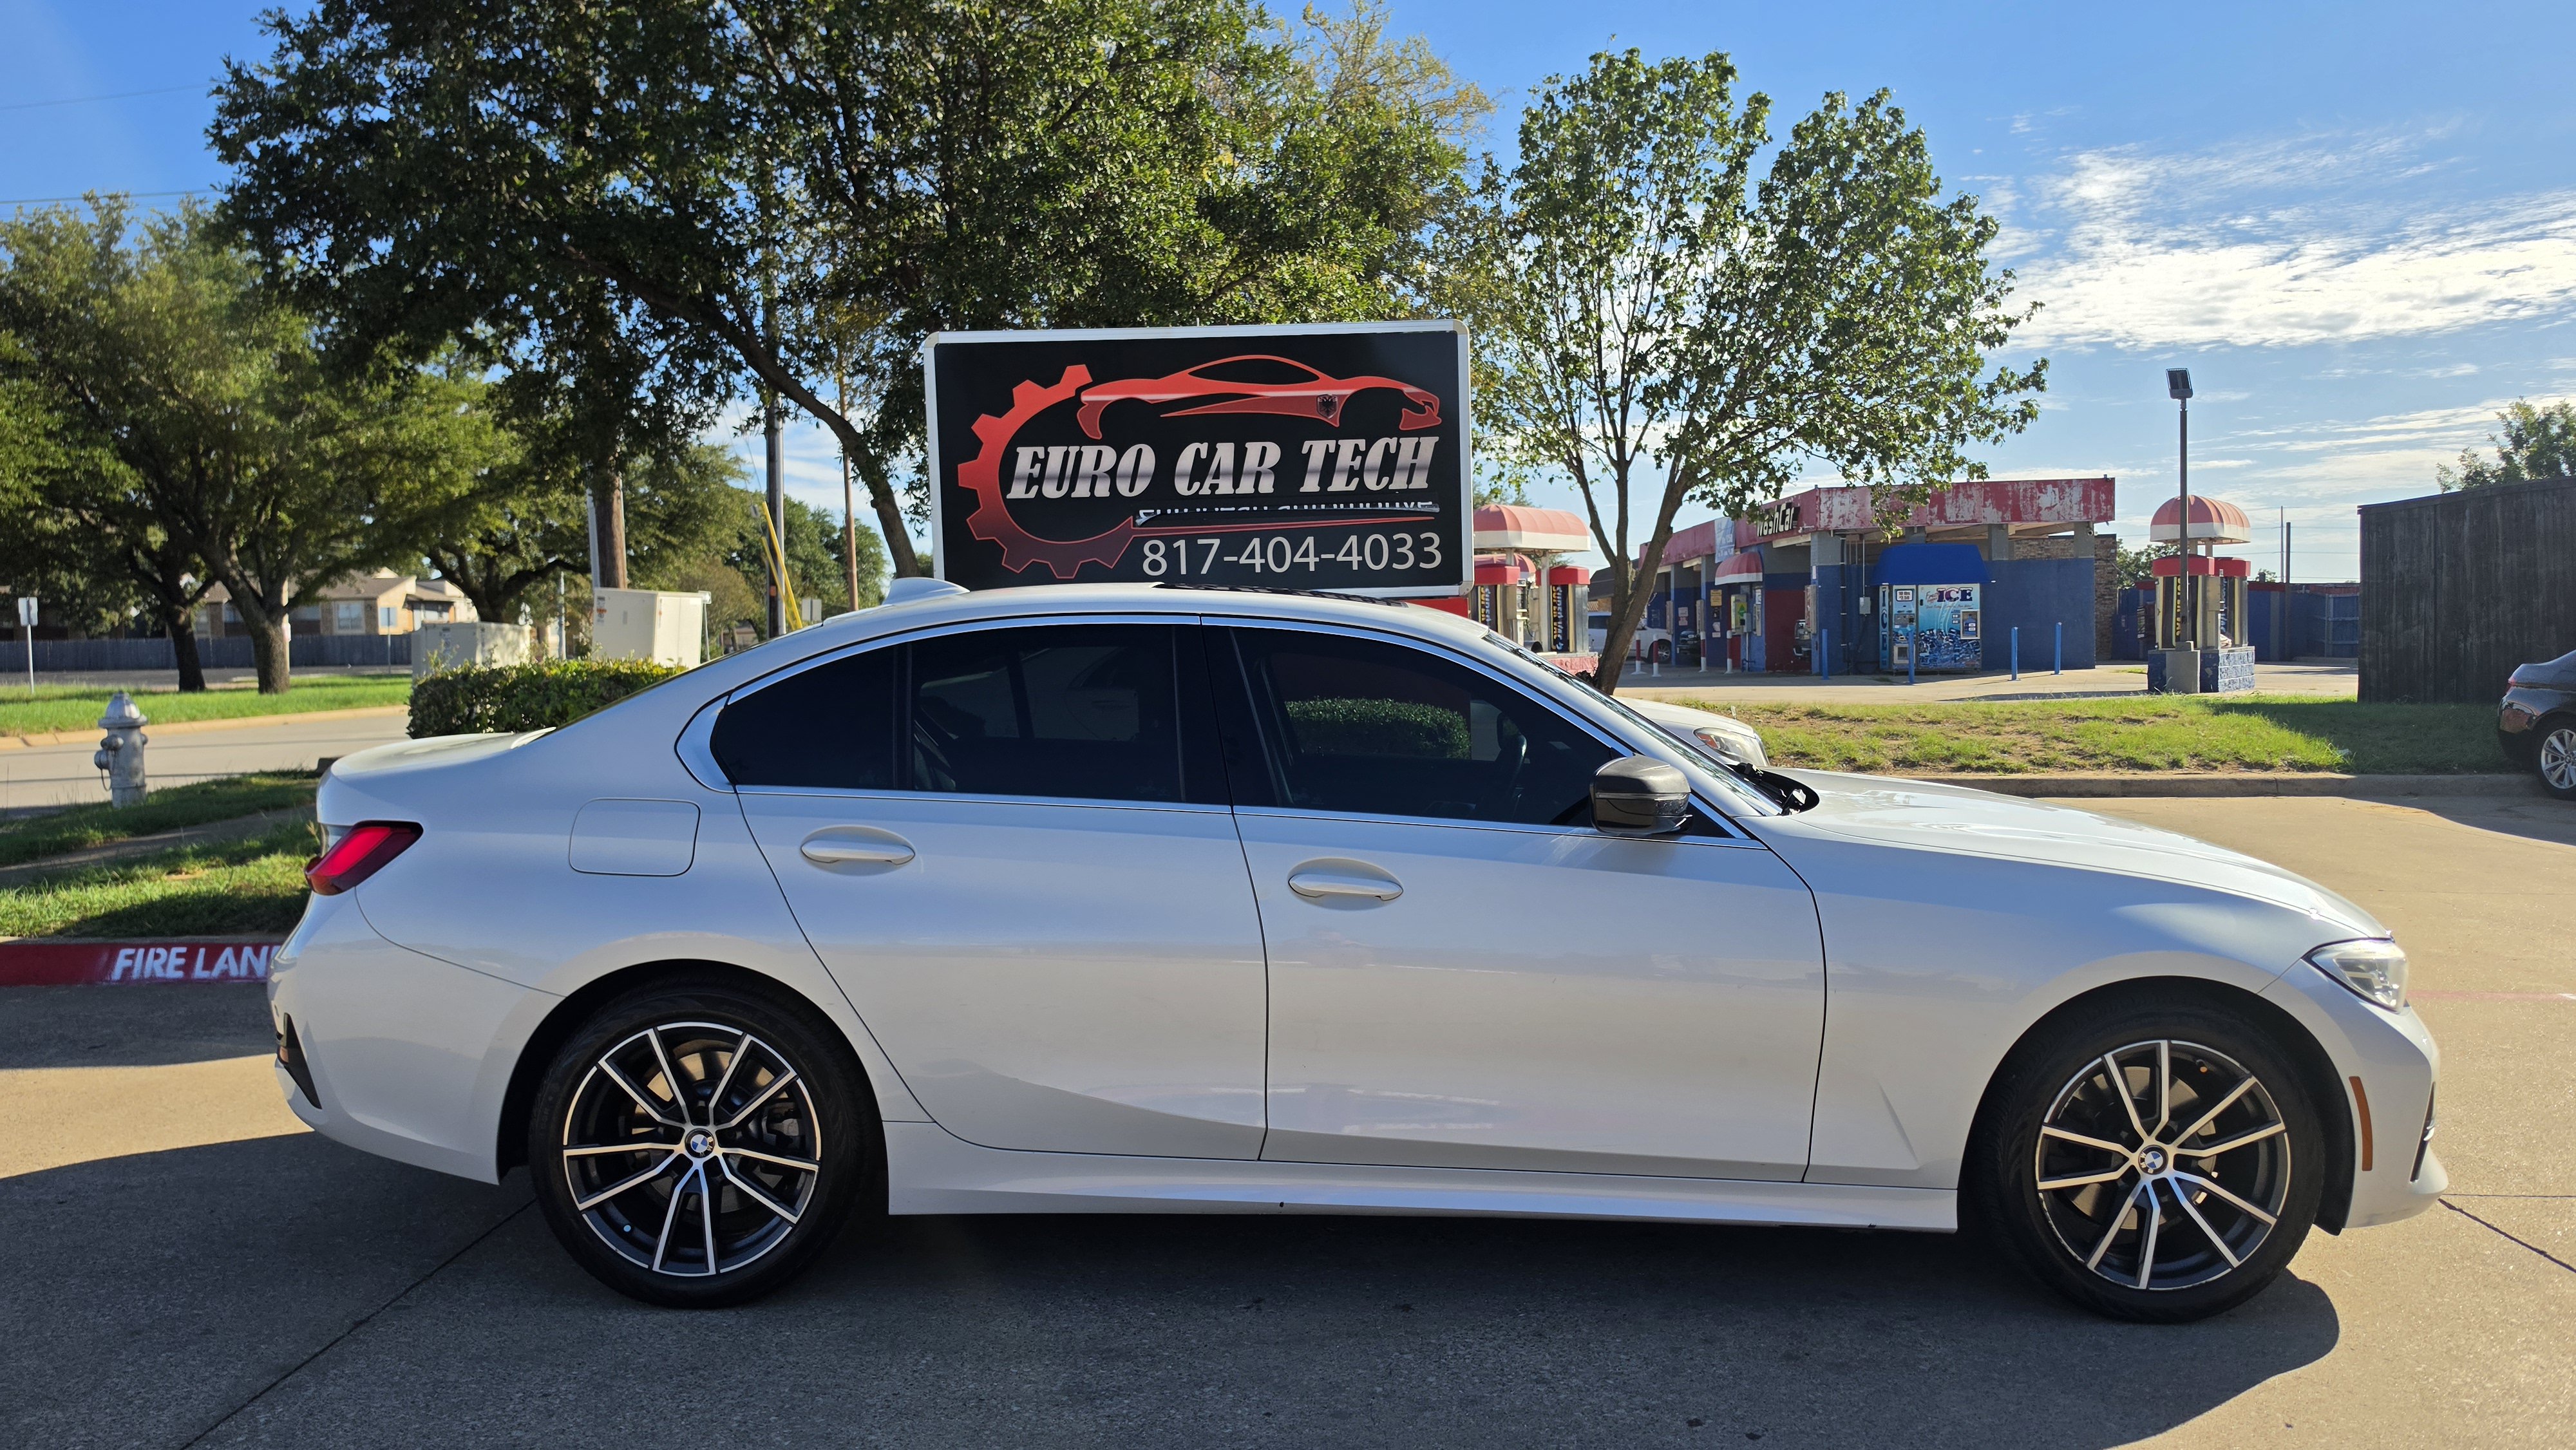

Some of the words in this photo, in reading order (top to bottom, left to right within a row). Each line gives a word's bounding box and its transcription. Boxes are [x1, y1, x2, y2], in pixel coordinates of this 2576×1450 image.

[1006, 443, 1156, 500] EURO
[1174, 441, 1282, 496] CAR
[1299, 436, 1440, 493] TECH
[1142, 532, 1443, 577] 817-404-4033
[1552, 586, 1564, 619] SUPER
[1937, 587, 1973, 602] ICE
[111, 946, 187, 981] FIRE
[193, 945, 279, 979] LAN
